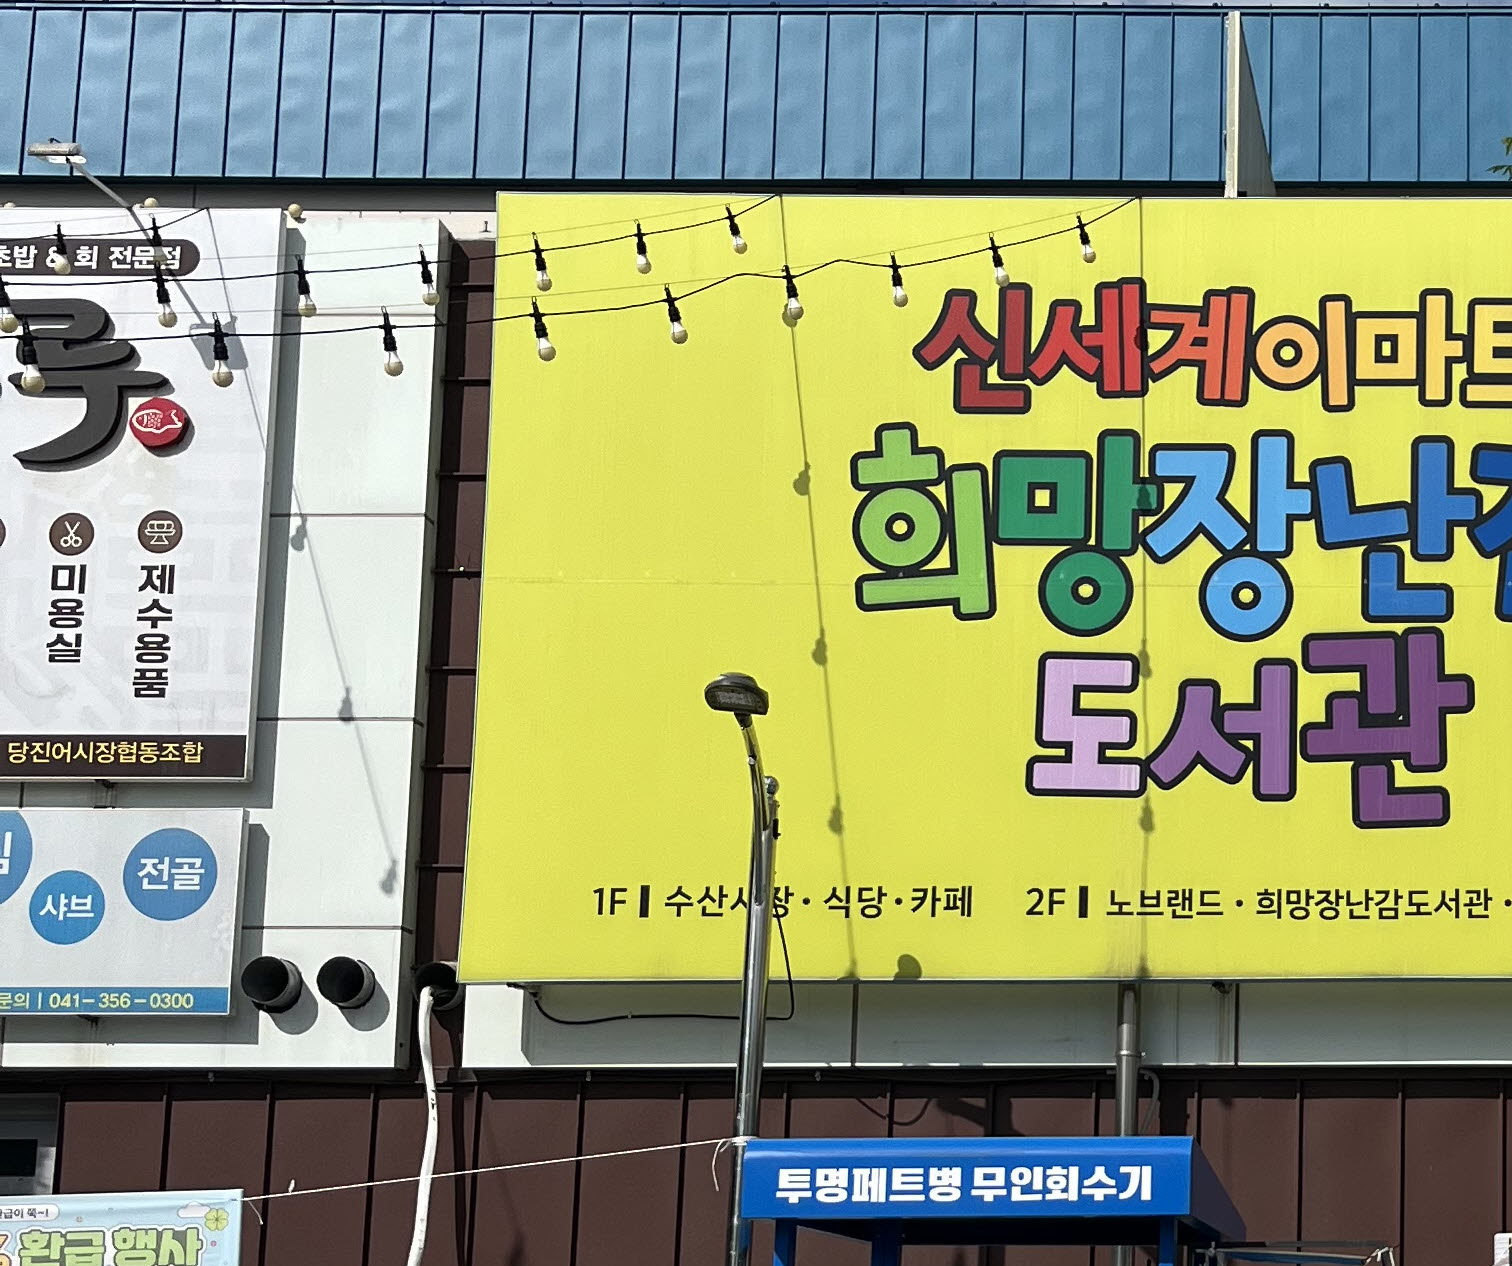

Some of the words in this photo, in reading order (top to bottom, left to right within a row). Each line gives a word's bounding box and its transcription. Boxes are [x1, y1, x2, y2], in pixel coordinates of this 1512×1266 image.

[74, 245, 98, 269] 회
[109, 245, 181, 270] 전문점
[46, 563, 87, 663] 미용실
[132, 563, 176, 698] 제수용품
[1026, 626, 1475, 829] 도서관
[8, 741, 204, 765] 당진어시장협동조합
[137, 856, 205, 891] 전골
[39, 893, 95, 920] 샤브
[592, 887, 628, 916] 1F
[823, 885, 887, 918] 식당
[911, 885, 972, 919] 카페
[1025, 887, 1066, 916] 2F
[1106, 886, 1224, 919] 노브랜드
[1256, 887, 1492, 921] 희망장난감도서관
[776, 1165, 962, 1204] 투명페트병
[971, 1165, 1152, 1202] 무인회수기
